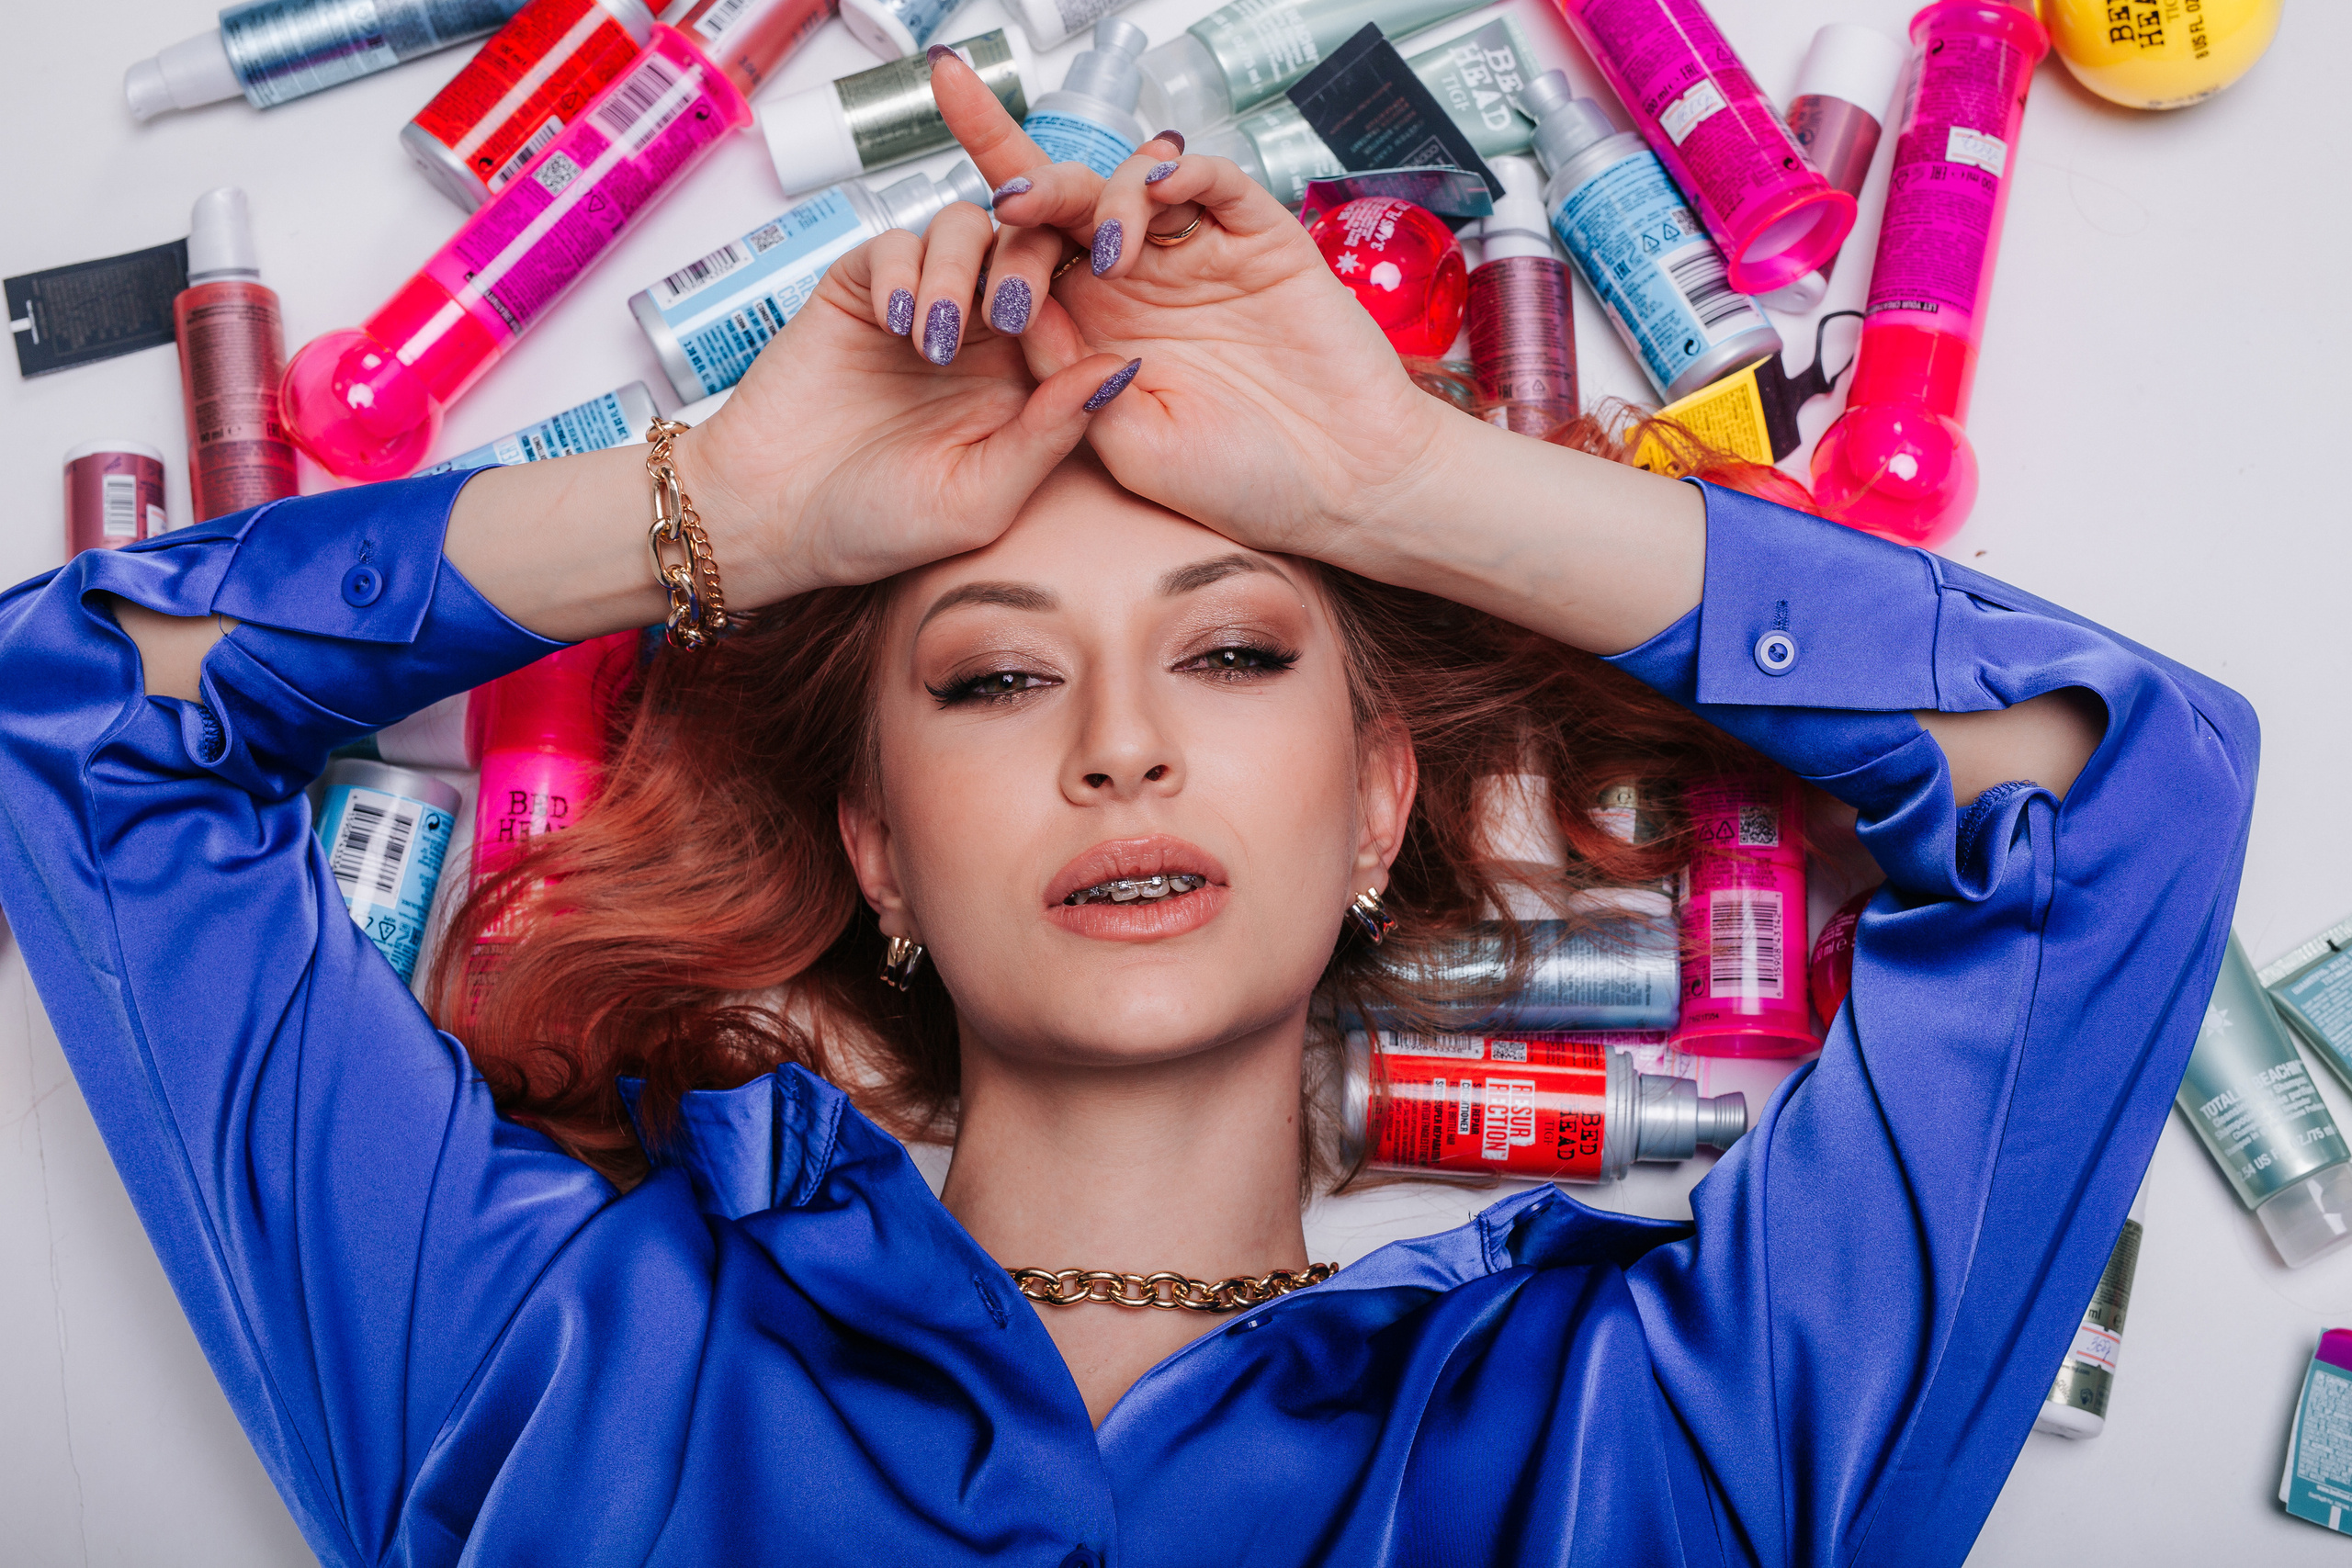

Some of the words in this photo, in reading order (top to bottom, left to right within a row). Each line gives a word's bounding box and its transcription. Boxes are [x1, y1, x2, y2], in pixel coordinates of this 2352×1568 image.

[2106, 0, 2134, 44] BE
[1447, 39, 1514, 135] HEAD
[775, 283, 803, 318] COV
[1920, 300, 1937, 312] LET
[507, 789, 569, 818] BED
[1432, 1100, 1442, 1123] SUPER
[1459, 1081, 1469, 1132] CONDITIONER
[1470, 1108, 1479, 1134] REPAIR
[1509, 1084, 1532, 1138] RESUR
[1556, 1102, 1578, 1160] HEAD
[1579, 1111, 1600, 1156] BED
[2253, 1152, 2272, 1170] US
[2087, 1305, 2102, 1320] ml
